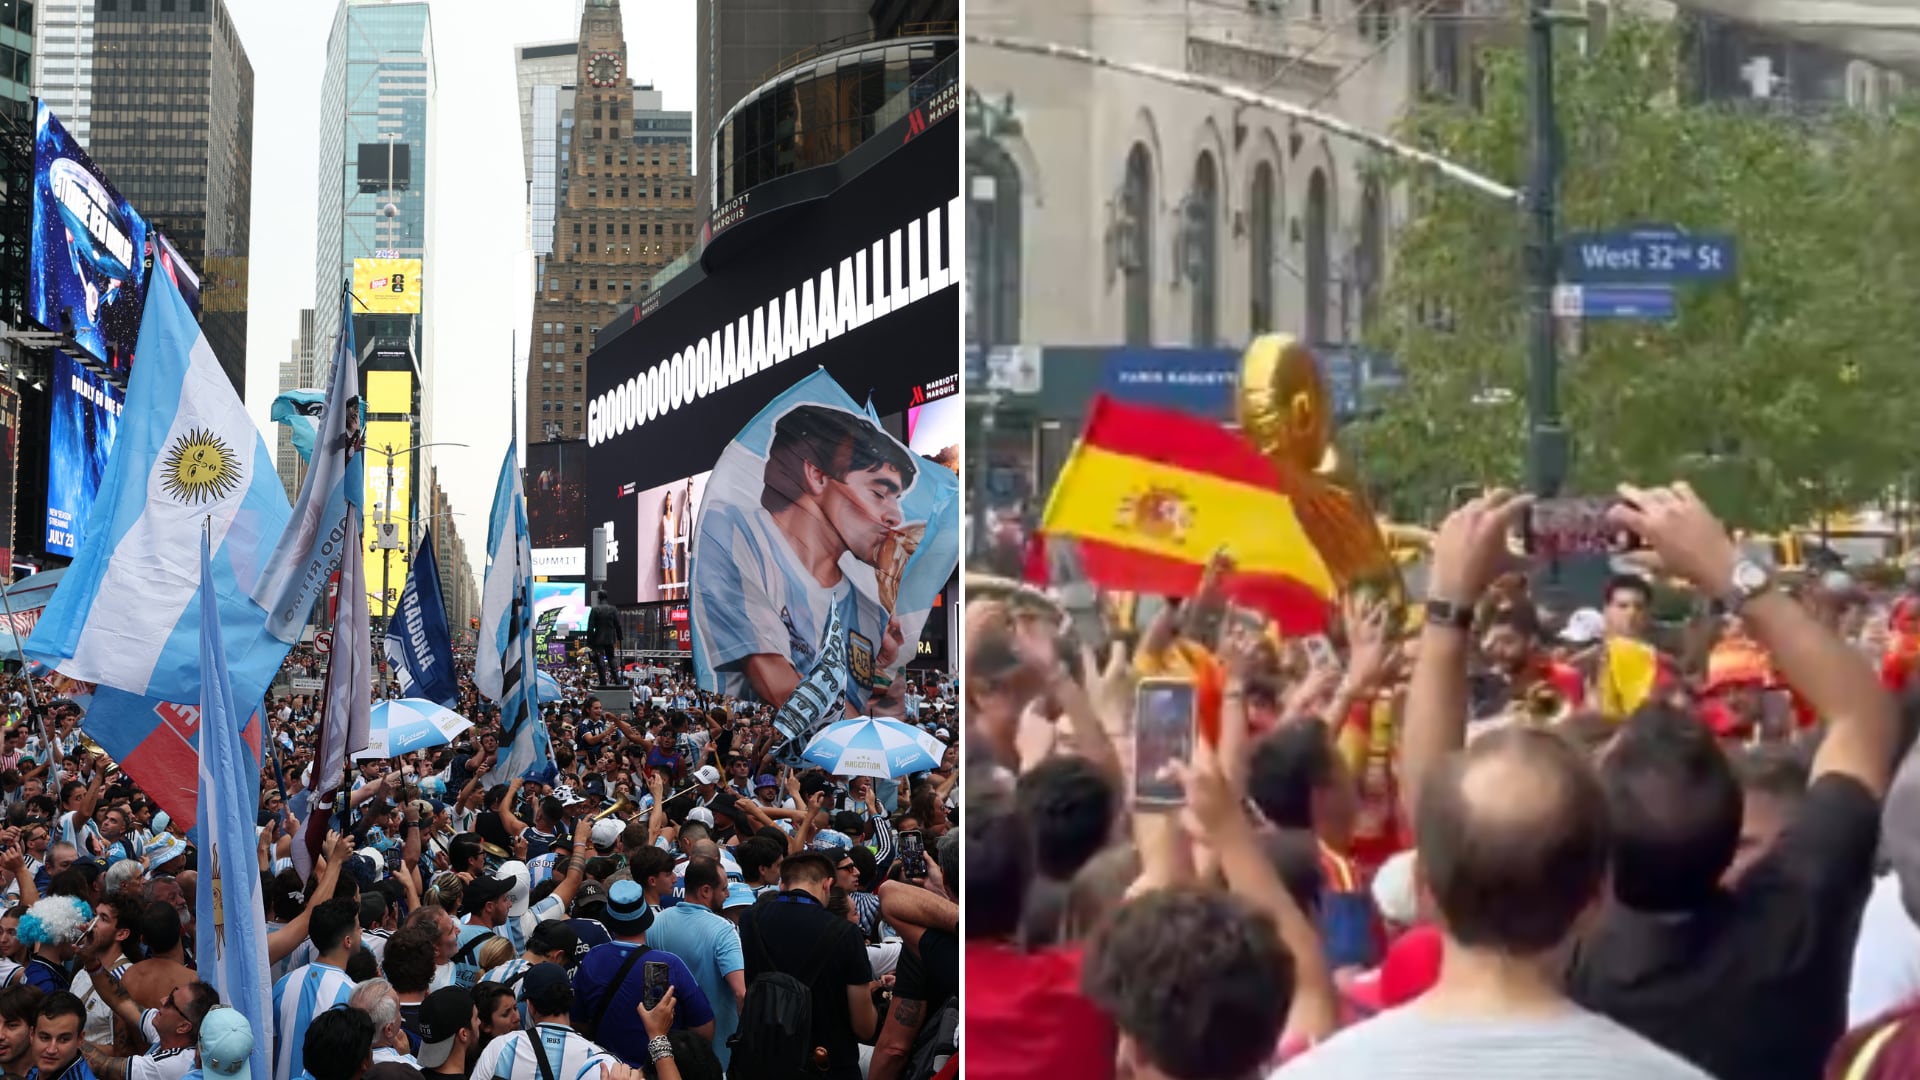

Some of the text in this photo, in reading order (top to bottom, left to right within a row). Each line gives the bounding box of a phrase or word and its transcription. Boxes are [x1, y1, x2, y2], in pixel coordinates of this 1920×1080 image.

[712, 193, 750, 221] MARRIOTT
[712, 208, 744, 234] MARQUIS
[1582, 245, 1640, 269] West
[1698, 245, 1721, 270] St
[926, 373, 959, 390] MARRIOTT
[926, 384, 955, 400] MARQUIS
[48, 529, 74, 548] JULY 23
[532, 556, 577, 566] SUMMIT
